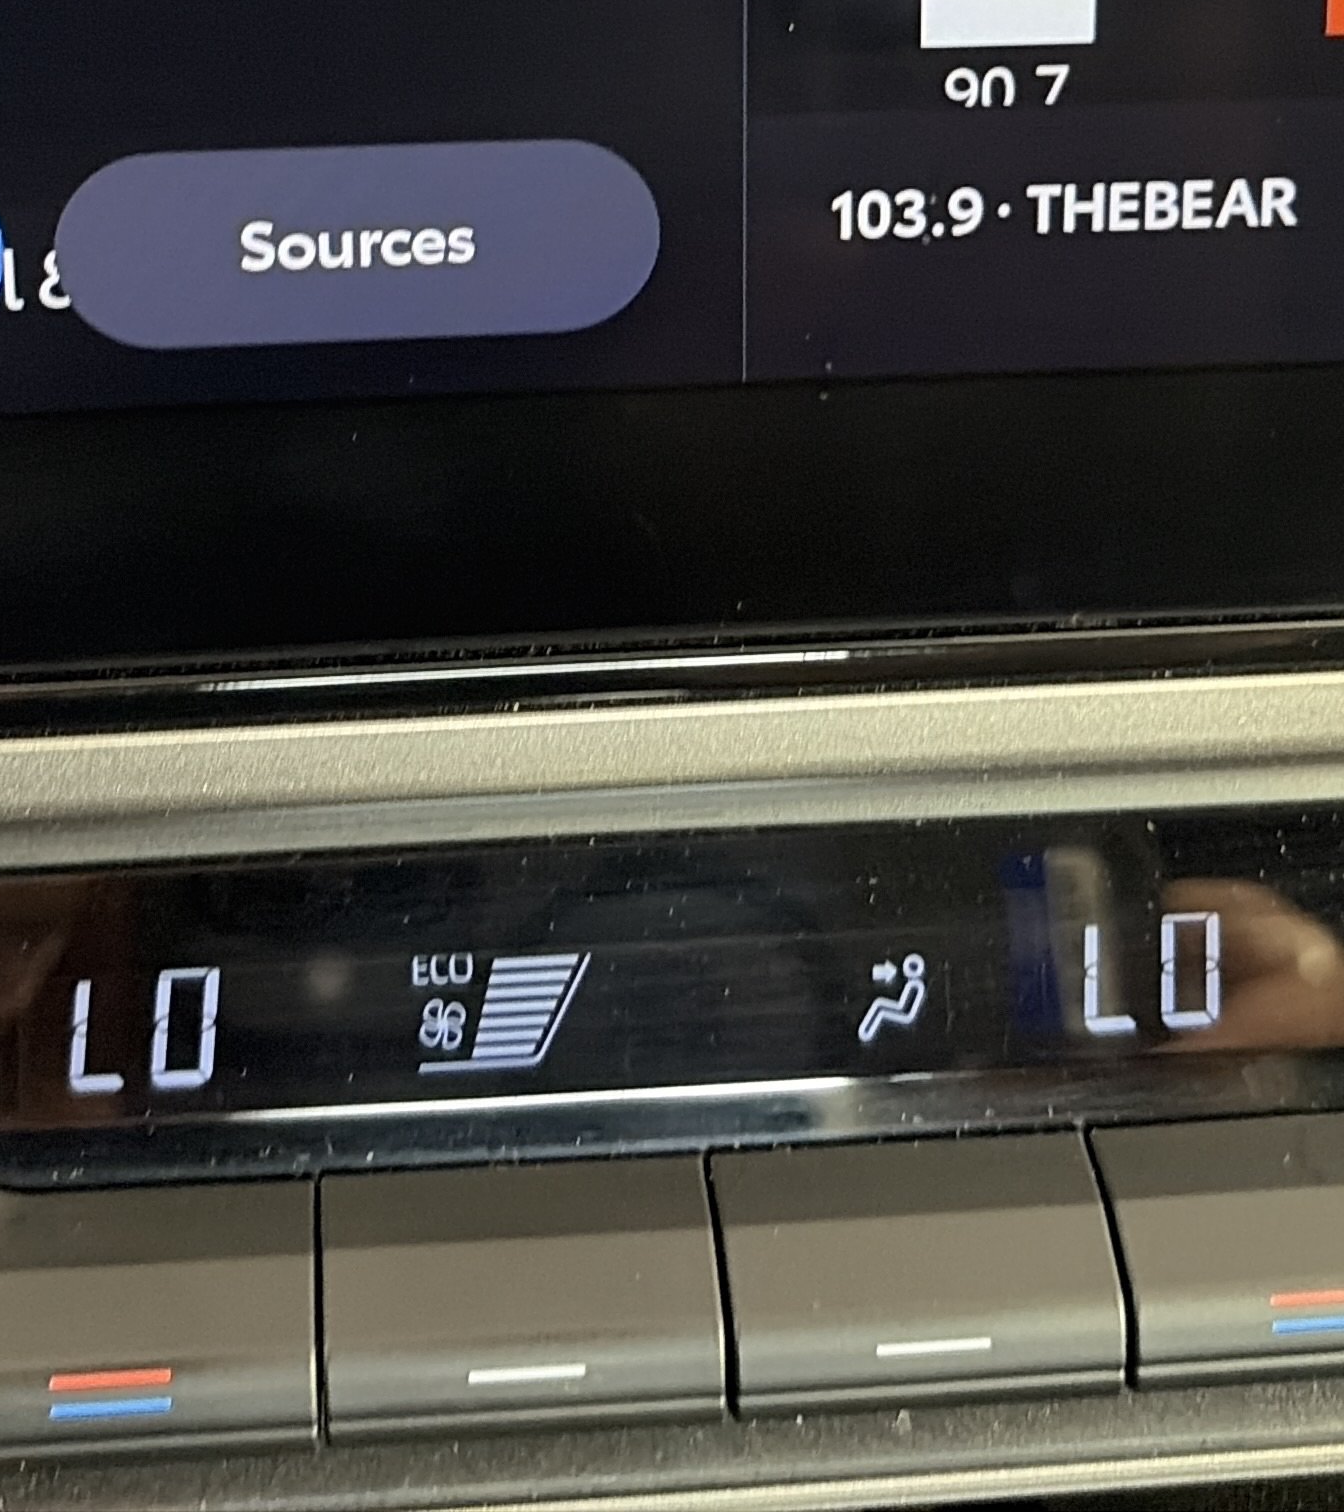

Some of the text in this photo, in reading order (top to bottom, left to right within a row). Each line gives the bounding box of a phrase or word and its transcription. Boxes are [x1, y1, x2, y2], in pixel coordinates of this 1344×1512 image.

[830, 177, 1298, 242] 103.9 THEBEAR
[239, 219, 476, 274] Sources
[412, 951, 474, 986] ECO
